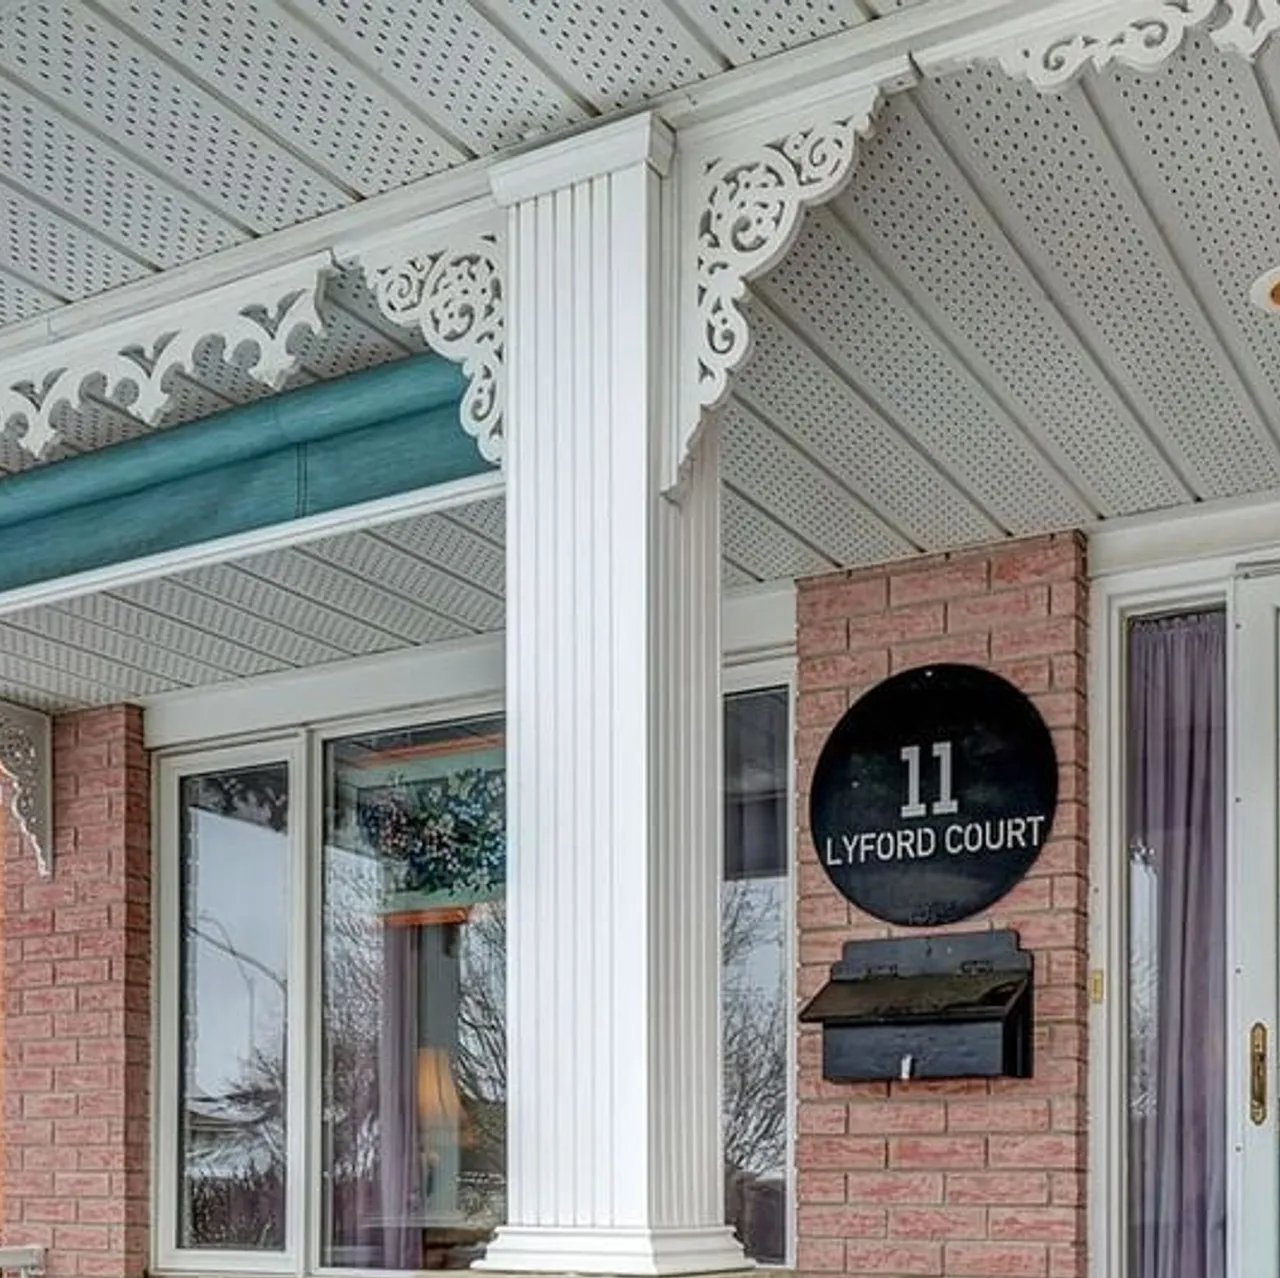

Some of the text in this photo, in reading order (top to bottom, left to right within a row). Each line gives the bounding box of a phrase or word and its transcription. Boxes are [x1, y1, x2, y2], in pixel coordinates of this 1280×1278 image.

[899, 740, 959, 819] 11
[826, 815, 1046, 866] LYFORD COURT
